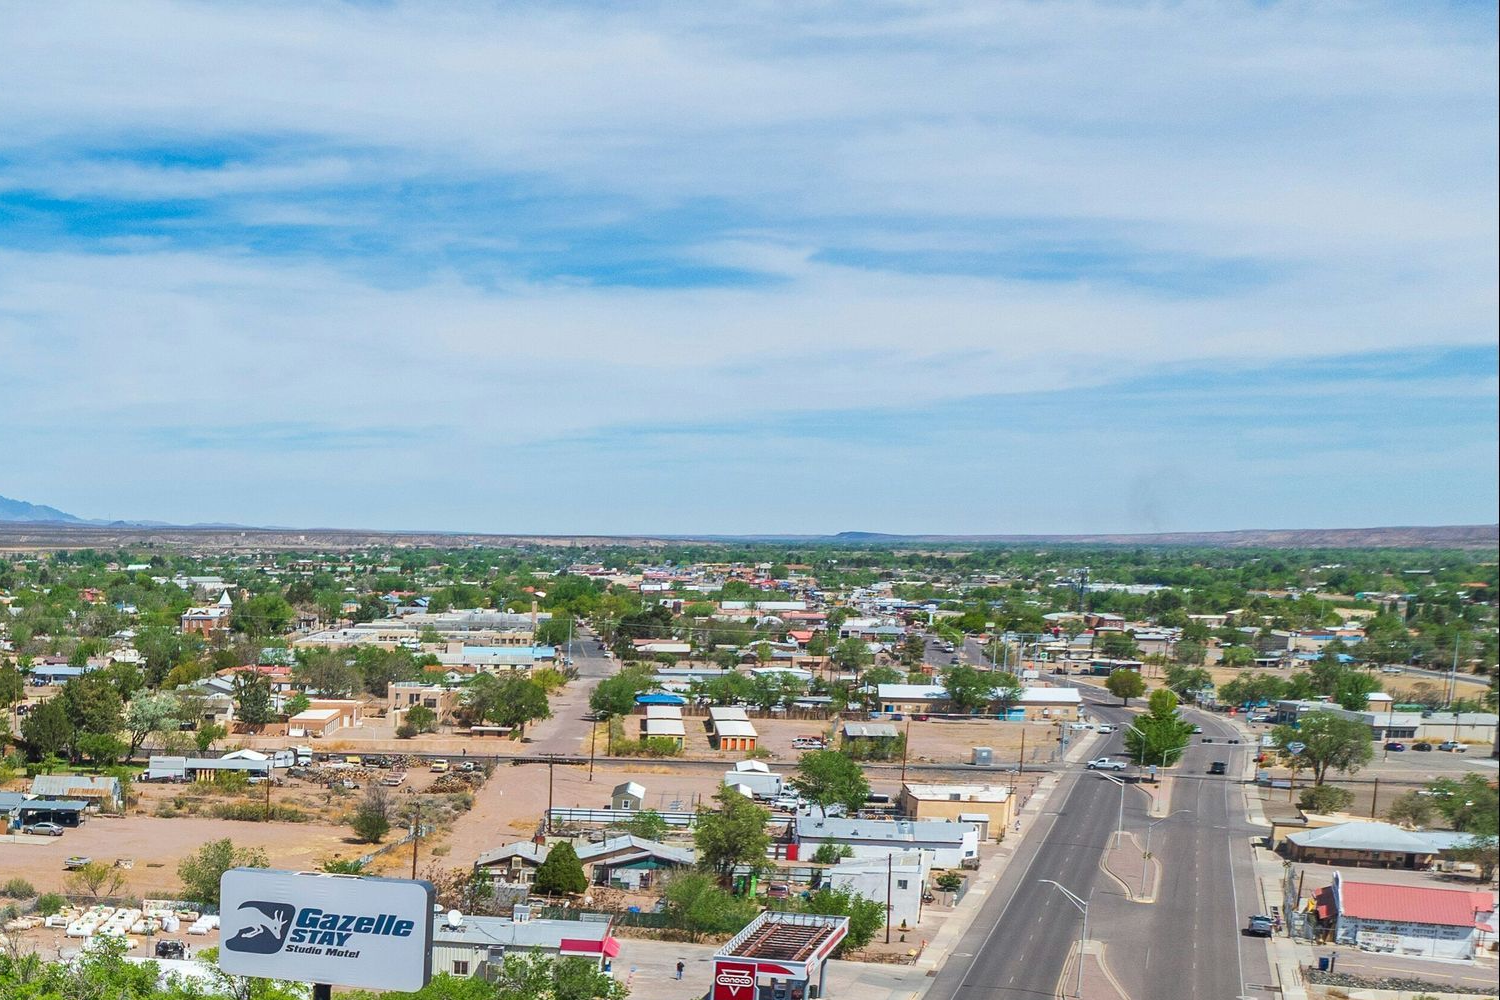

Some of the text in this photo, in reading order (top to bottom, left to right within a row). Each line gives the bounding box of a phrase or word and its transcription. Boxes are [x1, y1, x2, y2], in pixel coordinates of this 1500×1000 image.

[295, 907, 415, 937] Gazelle
[289, 928, 352, 947] STAY
[285, 944, 360, 959] Studio Motel
